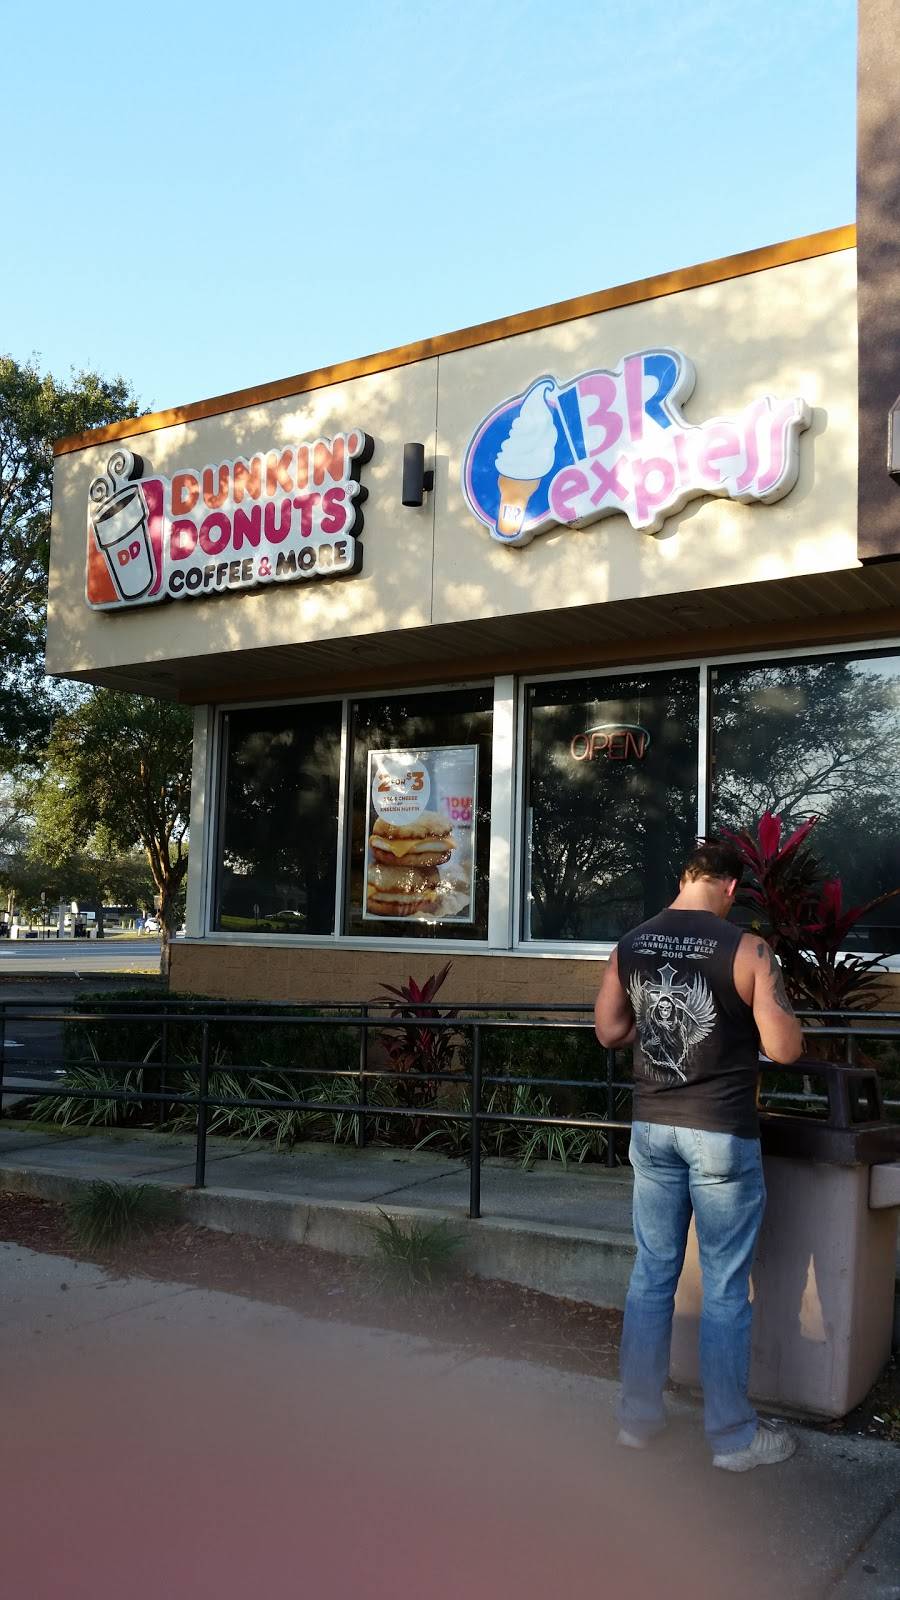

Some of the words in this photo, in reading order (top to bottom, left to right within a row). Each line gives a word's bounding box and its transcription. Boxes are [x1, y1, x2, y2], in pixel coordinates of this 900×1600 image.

[171, 432, 358, 515] DUNKIN'
[551, 397, 800, 521] express
[171, 487, 348, 560] DONUTS
[117, 540, 141, 567] DD
[168, 557, 254, 593] COFFEE
[257, 556, 272, 577] &
[276, 540, 348, 575] MORE
[571, 732, 645, 761] OPEN
[661, 950, 684, 959] 2016
[682, 936, 718, 948] BEACH
